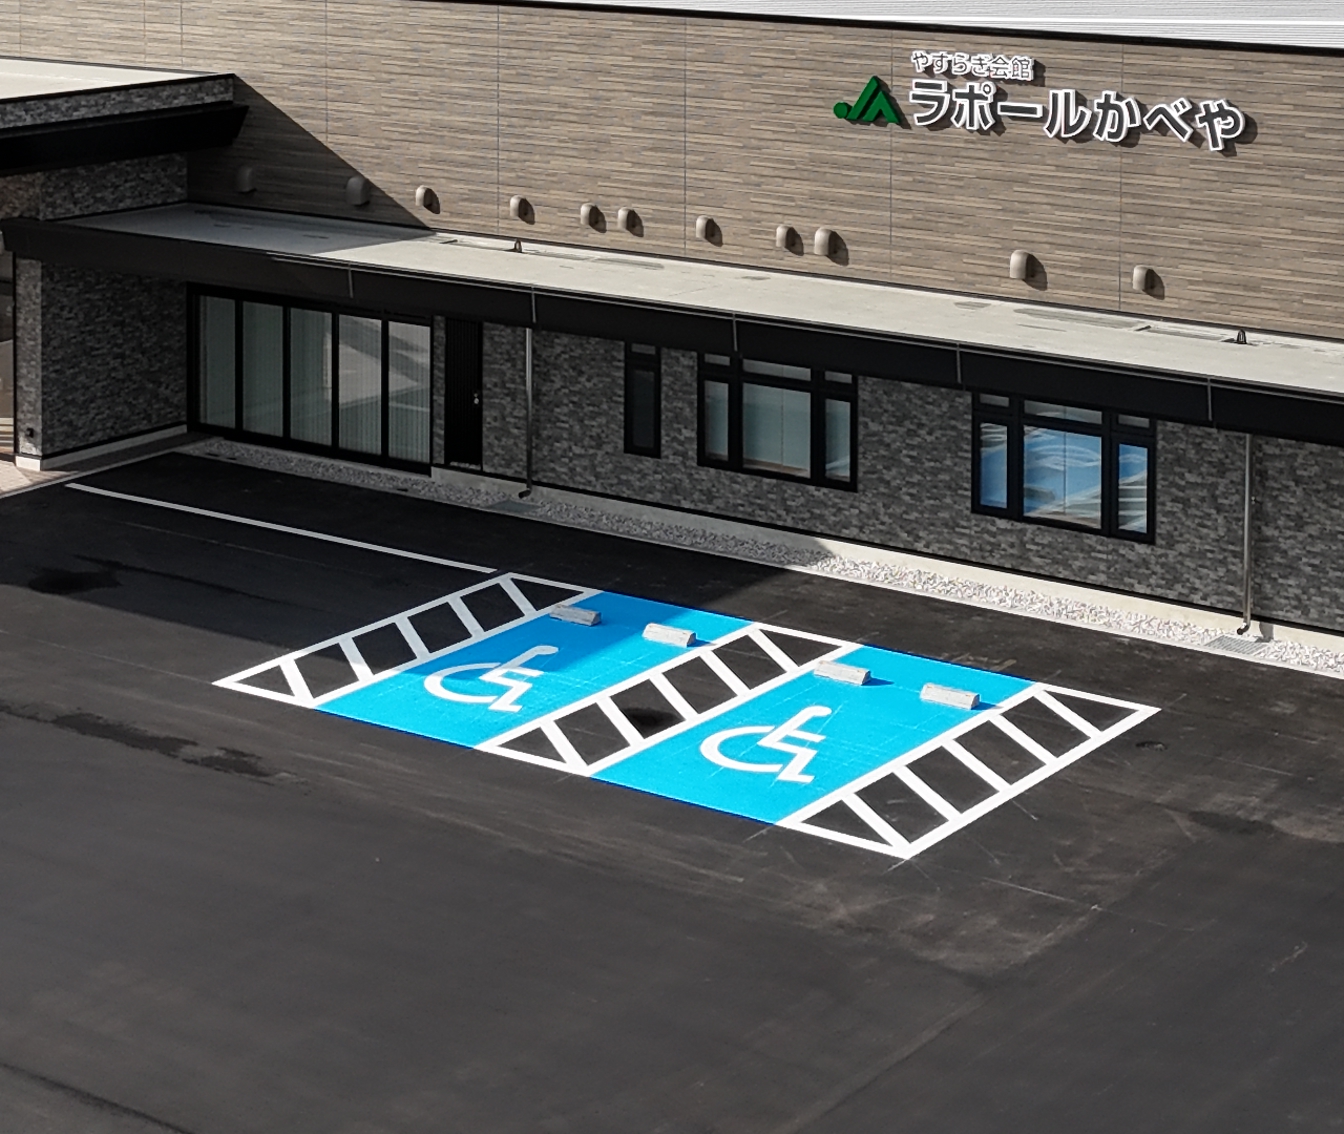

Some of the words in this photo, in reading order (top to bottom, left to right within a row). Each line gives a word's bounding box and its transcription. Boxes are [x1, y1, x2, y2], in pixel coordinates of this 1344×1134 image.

[911, 51, 1034, 81] やすらぎ会館
[910, 79, 1245, 151] ラポールかべや
